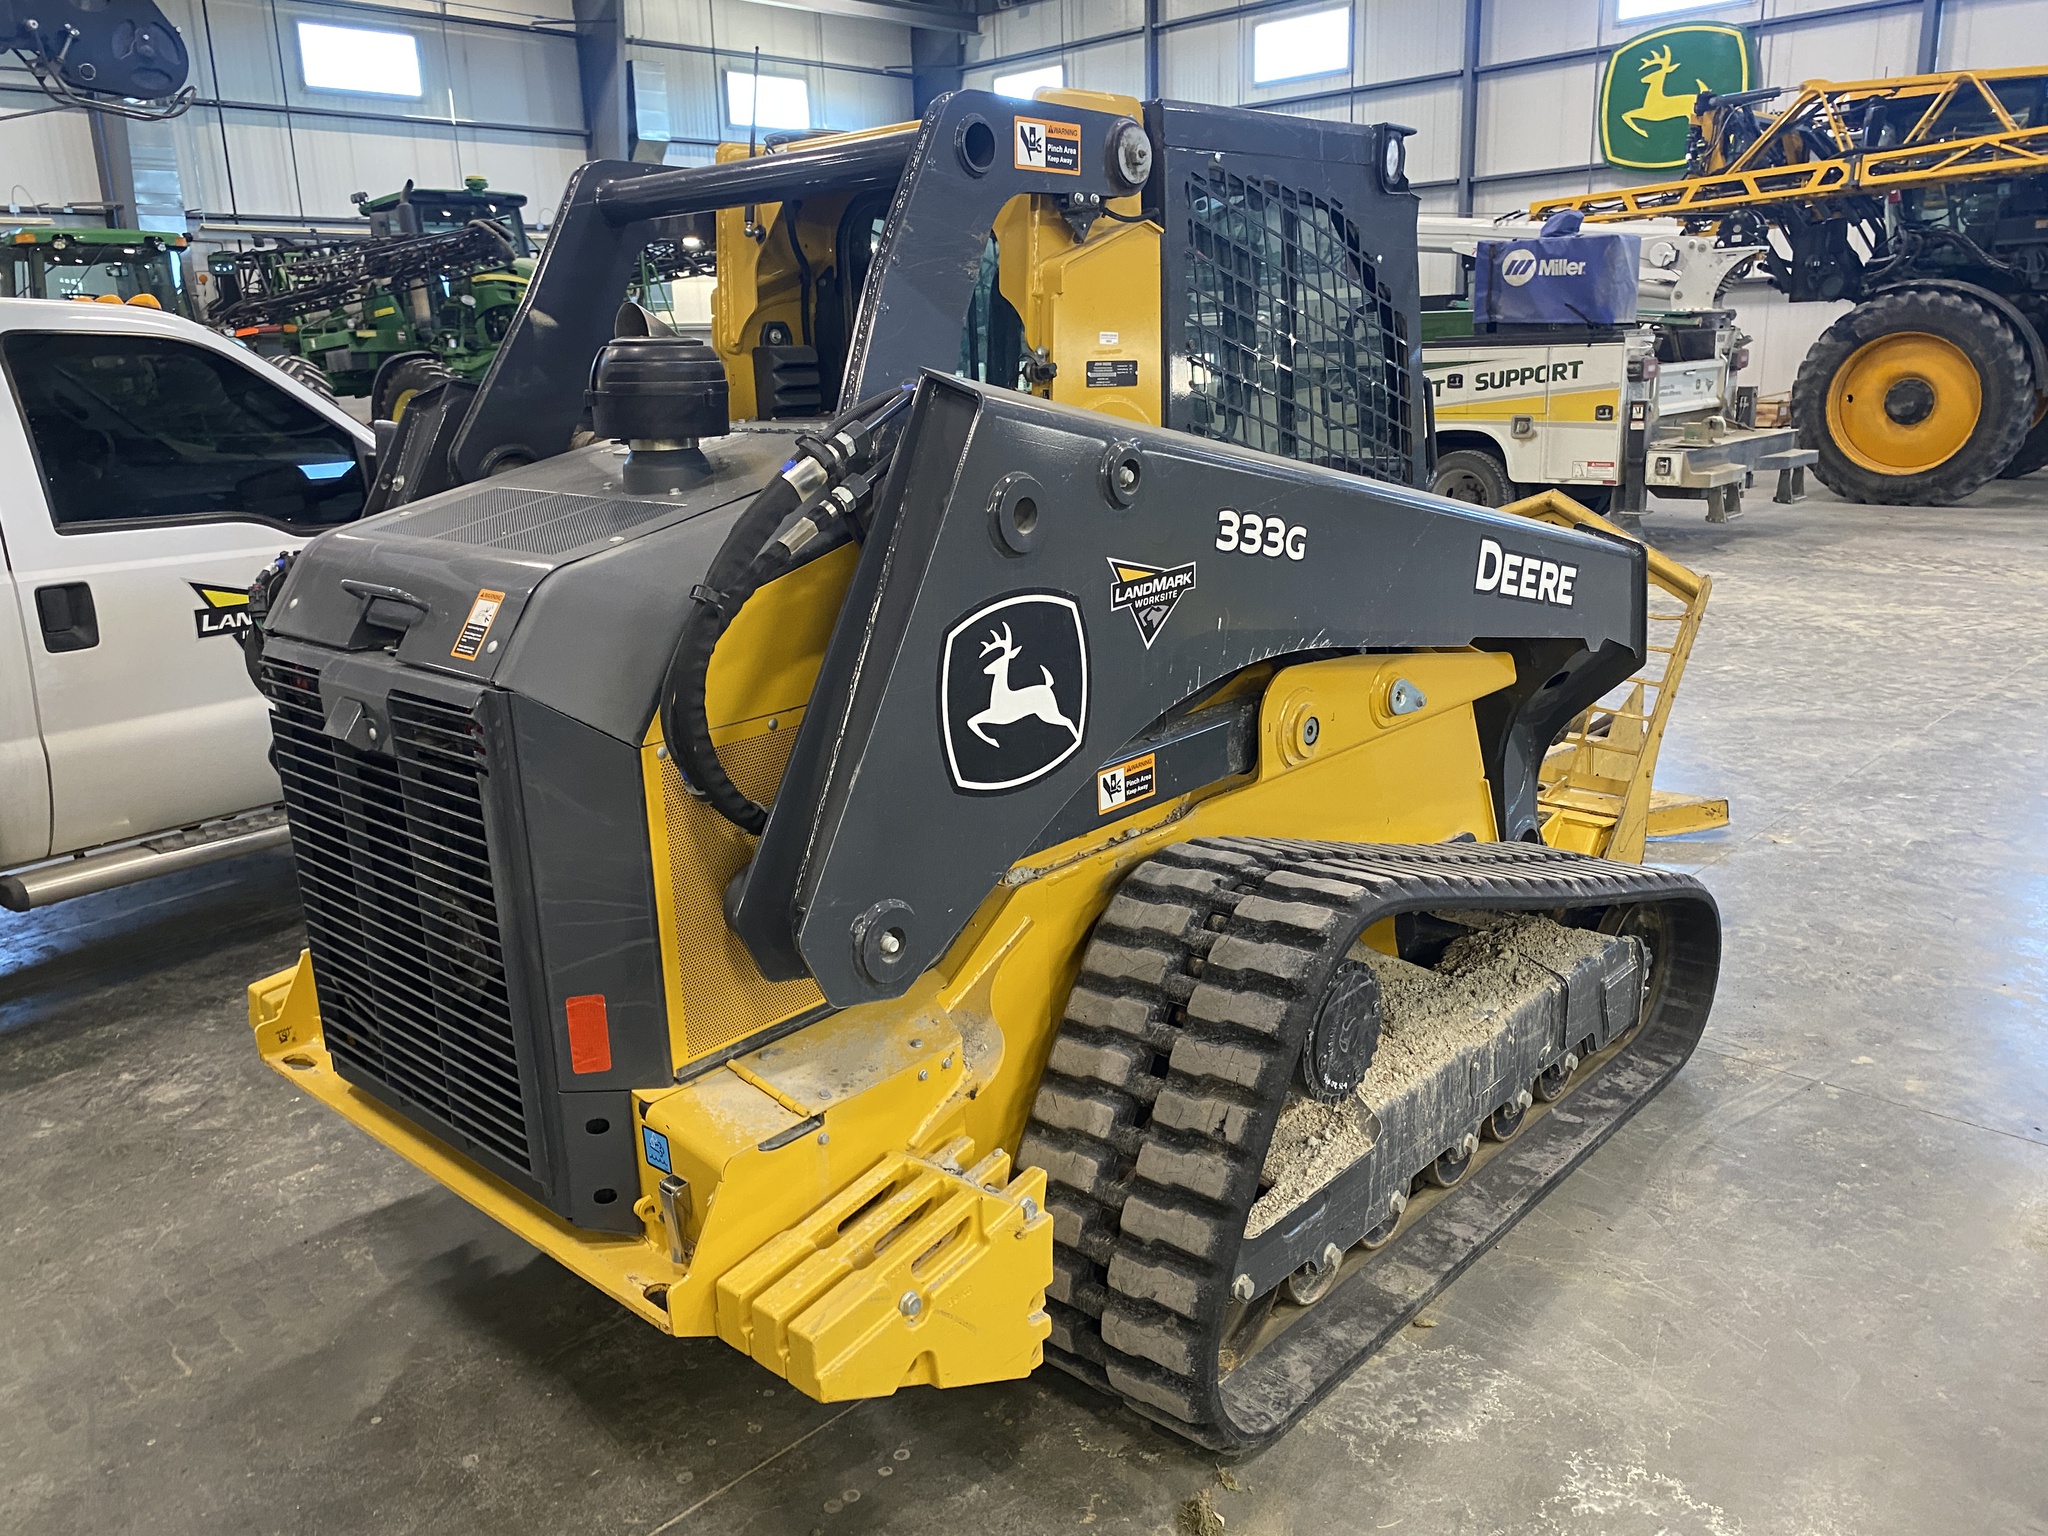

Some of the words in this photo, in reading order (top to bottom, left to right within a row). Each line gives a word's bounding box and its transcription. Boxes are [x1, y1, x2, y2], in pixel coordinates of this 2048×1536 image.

[1047, 143, 1063, 153] Pinch
[1063, 145, 1077, 155] Area
[1047, 155, 1060, 163] Keep
[1060, 156, 1073, 165] Away
[1538, 258, 1586, 276] Miller
[1475, 360, 1584, 391] SUPPORT
[1215, 509, 1308, 561] 333G
[1475, 538, 1578, 606] DEERE
[1114, 571, 1193, 603] LANDMARK
[1134, 589, 1178, 608] WORKSITE
[1126, 777, 1140, 788] Pinch
[1140, 774, 1152, 782] Area
